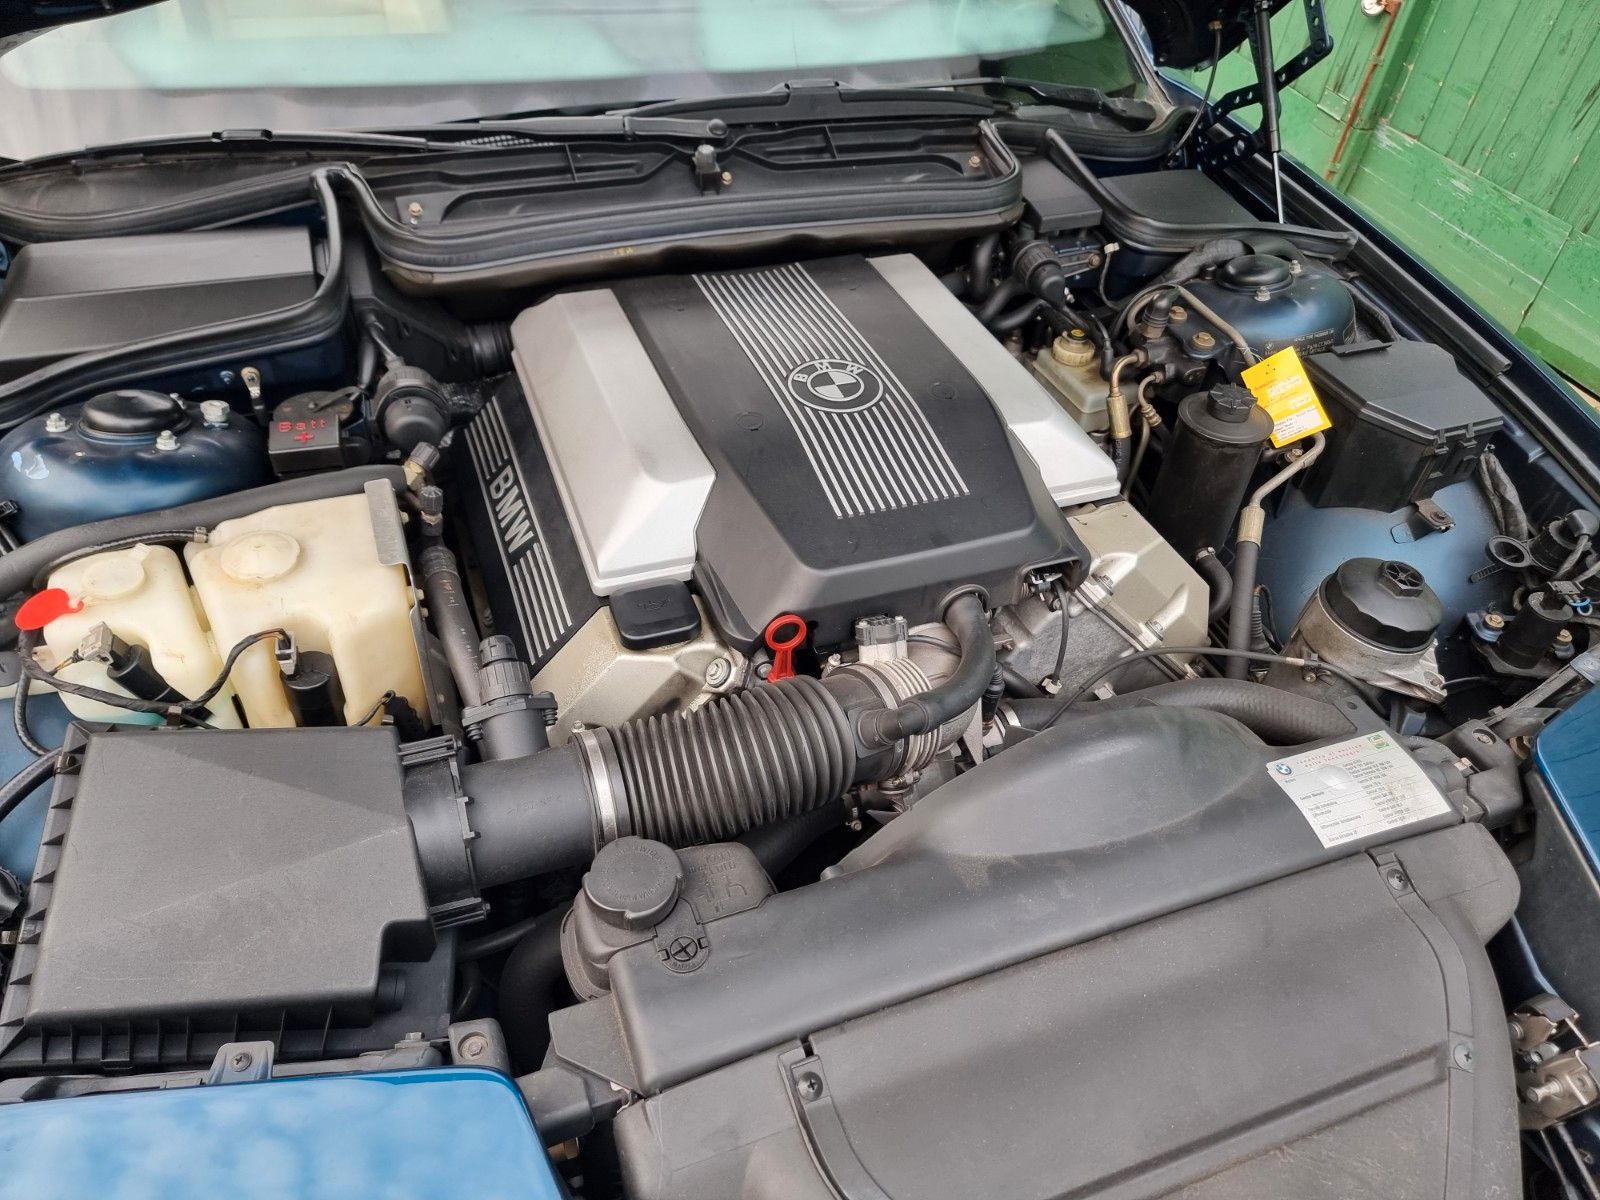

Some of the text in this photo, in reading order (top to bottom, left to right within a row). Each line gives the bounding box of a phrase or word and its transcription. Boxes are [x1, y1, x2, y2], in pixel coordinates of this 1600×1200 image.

[793, 361, 864, 383] BMW
[277, 417, 327, 433] Batt
[489, 465, 534, 554] BMW
